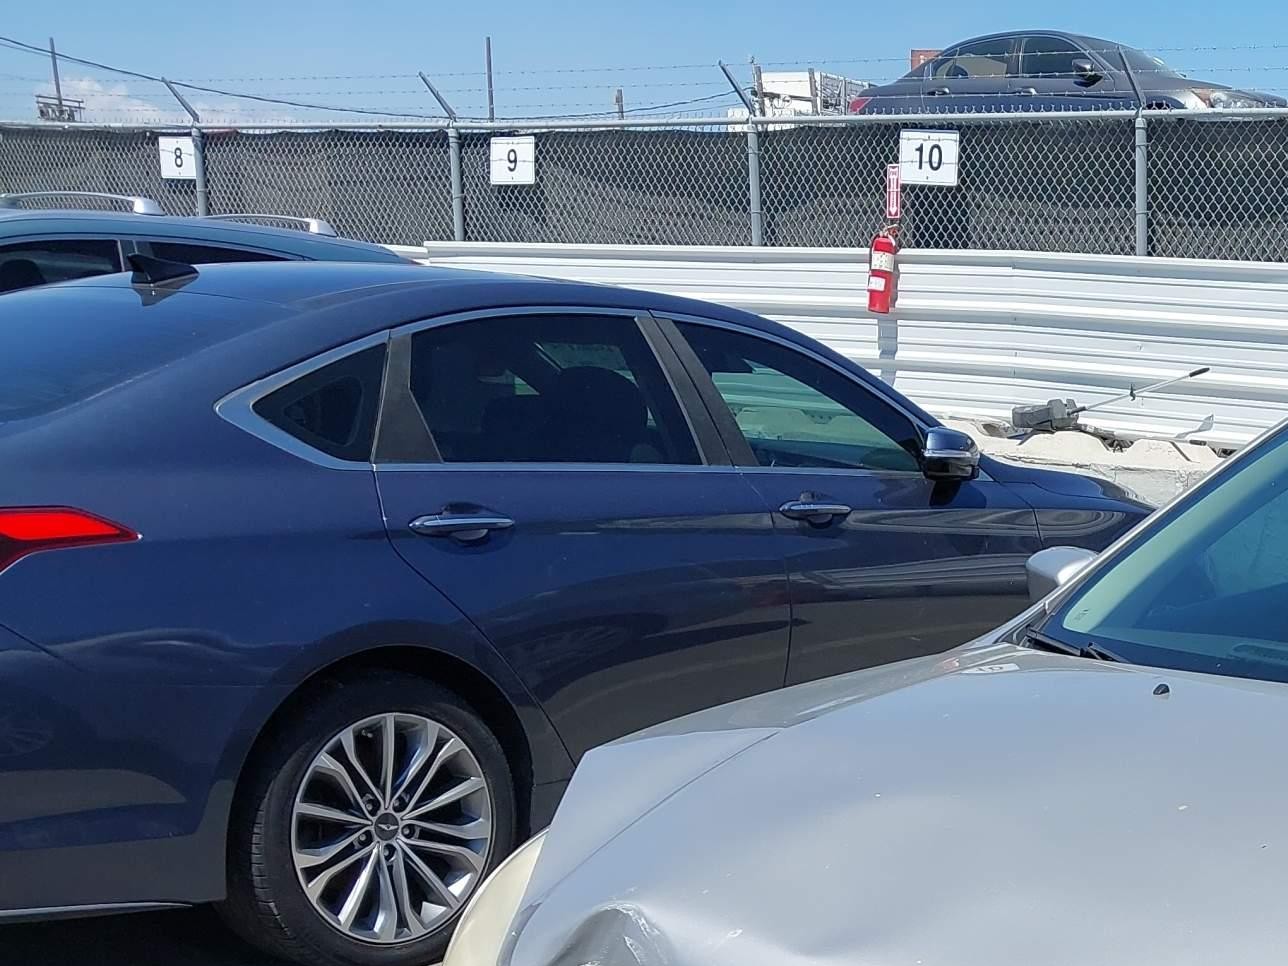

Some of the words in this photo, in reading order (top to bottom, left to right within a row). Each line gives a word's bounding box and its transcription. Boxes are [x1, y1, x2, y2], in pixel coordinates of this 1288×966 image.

[173, 146, 184, 169] 8
[506, 148, 518, 173] 9
[914, 143, 943, 172] 10
